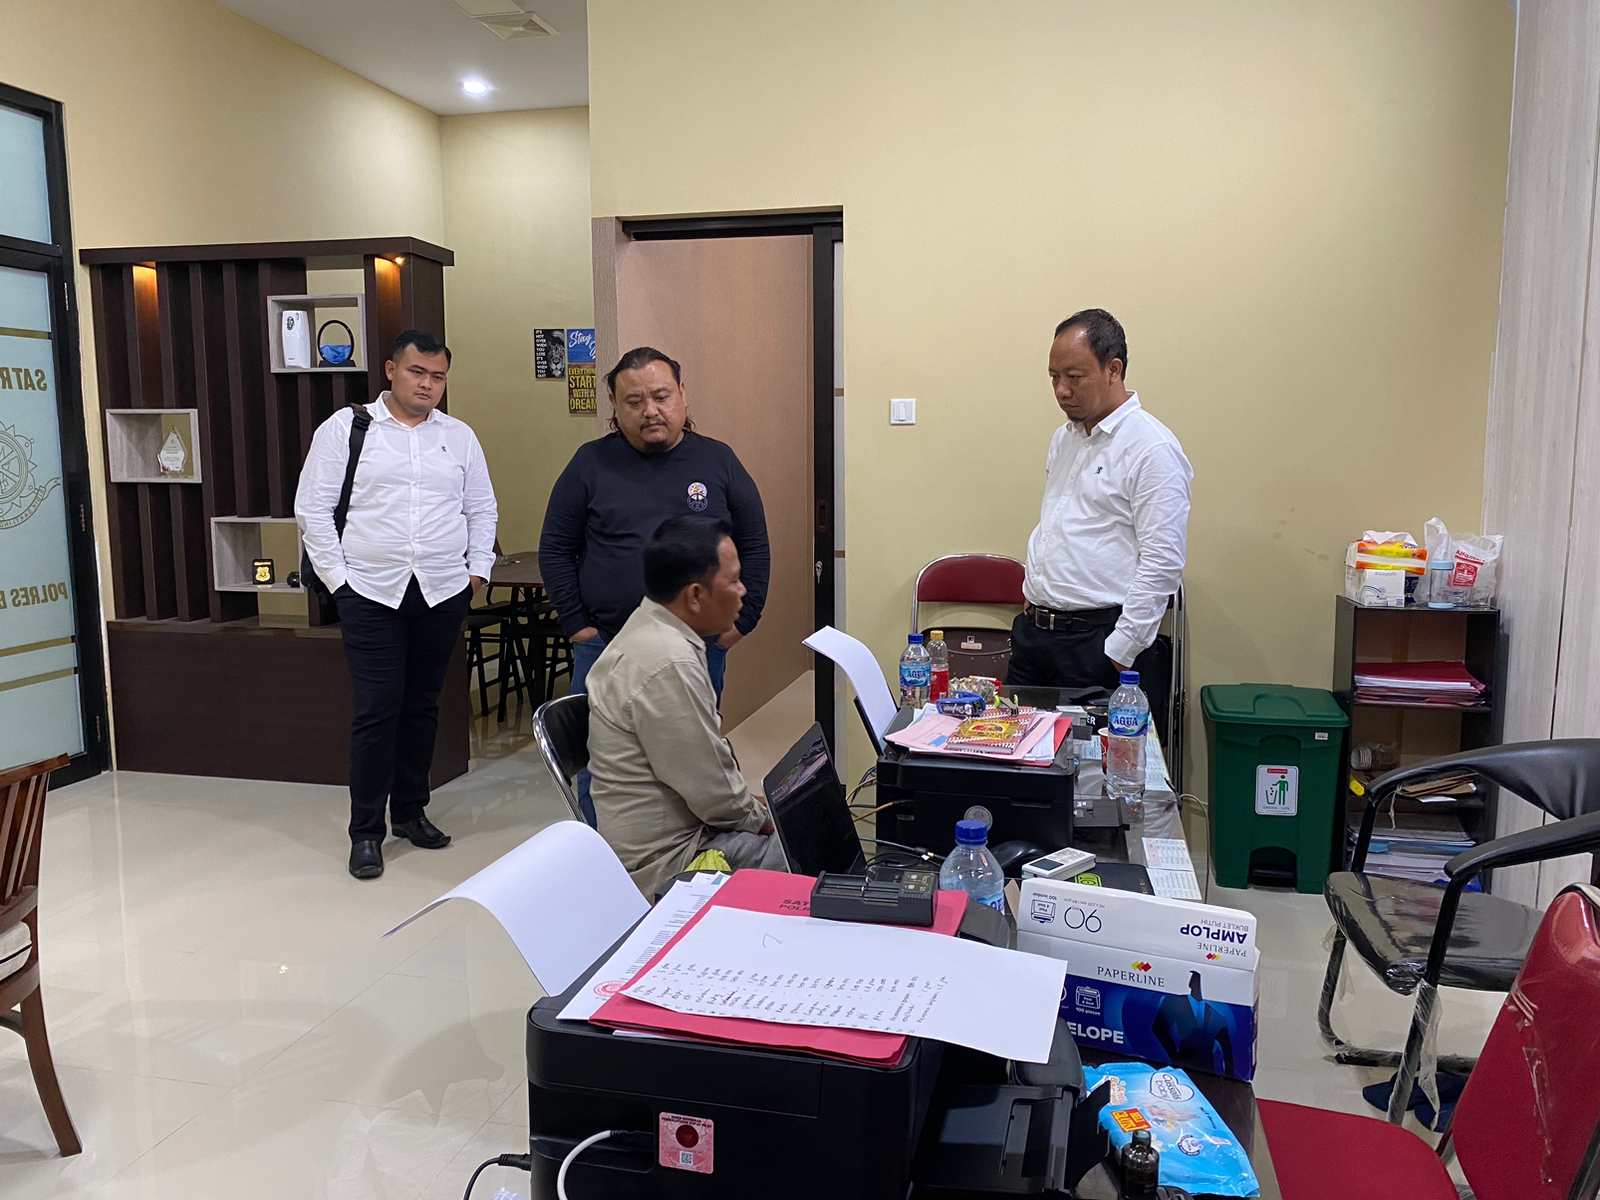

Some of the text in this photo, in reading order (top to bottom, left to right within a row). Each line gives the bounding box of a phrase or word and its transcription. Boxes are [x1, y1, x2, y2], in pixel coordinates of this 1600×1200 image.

[569, 331, 592, 348] Stay
[573, 389, 595, 398] WITH A
[907, 671, 926, 679] AQUA
[1114, 716, 1138, 727] AQUA
[1064, 907, 1102, 933] 90
[1201, 919, 1249, 932] BUKLET PUTIH
[1180, 924, 1248, 944] AMPLOP
[1197, 942, 1247, 957] PAPERLINE
[1097, 966, 1165, 987] PAPERLINE
